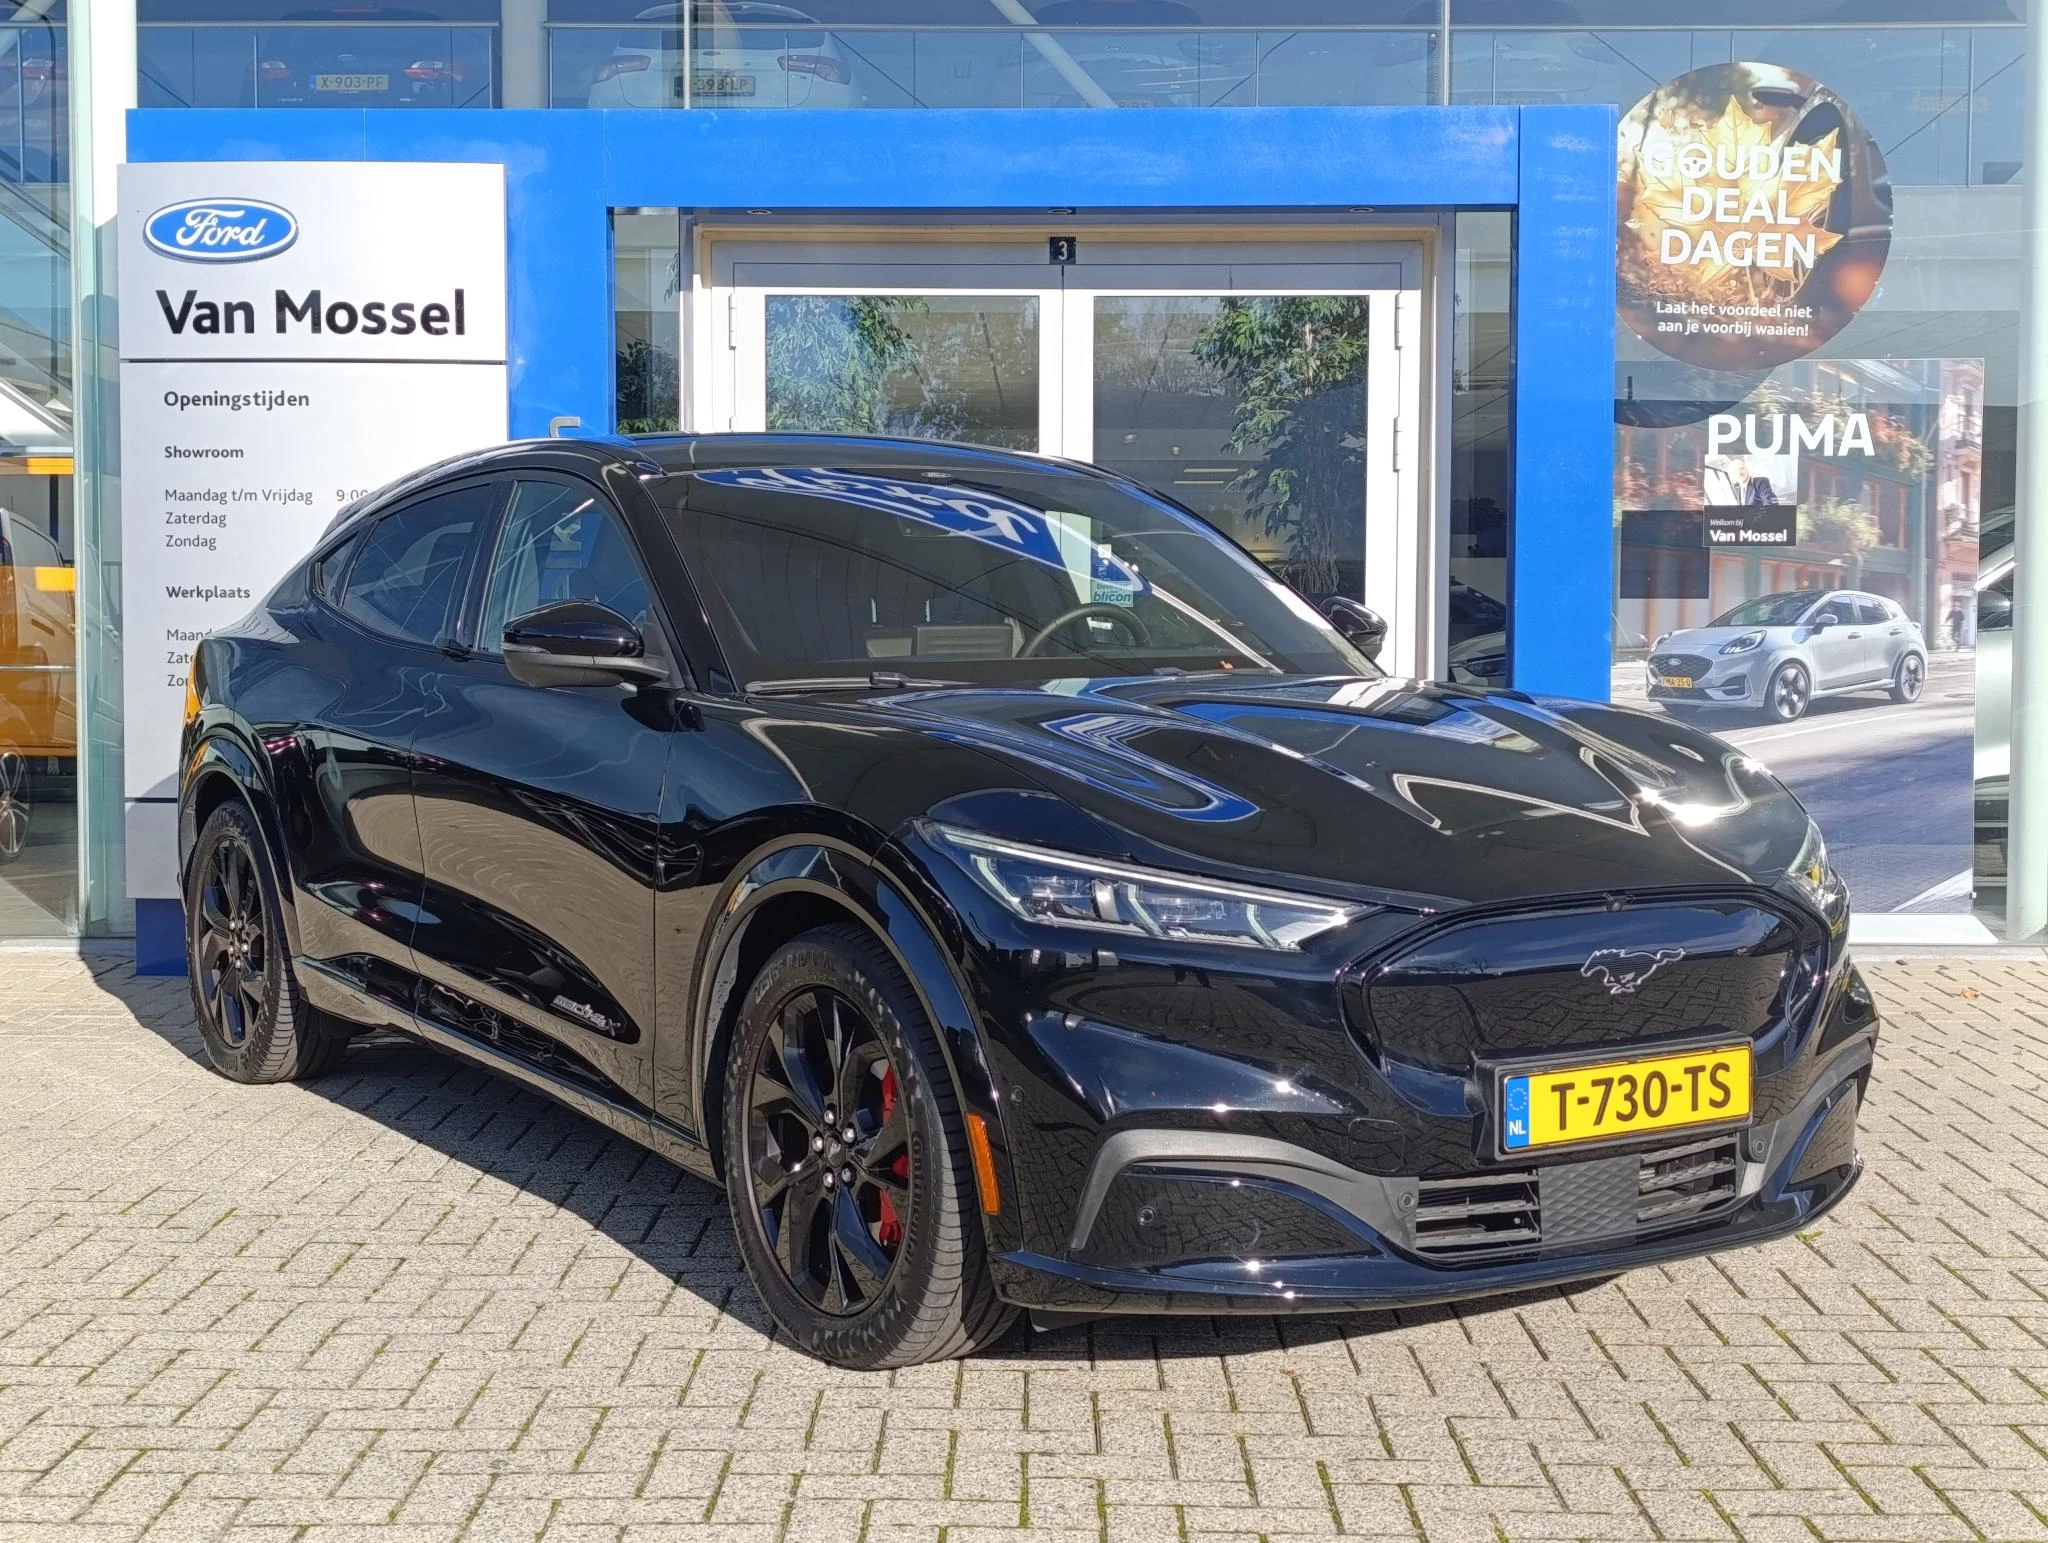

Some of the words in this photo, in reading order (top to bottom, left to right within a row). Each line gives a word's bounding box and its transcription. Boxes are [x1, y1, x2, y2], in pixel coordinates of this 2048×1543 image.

[320, 76, 384, 88] X-903-PF
[686, 78, 748, 91] -398-LP
[1643, 142, 1842, 184] GOUDEN
[1682, 186, 1801, 225] DEAL
[175, 208, 268, 246] Ford
[1058, 240, 1068, 261] 3
[1660, 229, 1816, 269] DAGEN
[155, 289, 255, 335] Van
[275, 288, 465, 336] Mossel
[1656, 301, 1688, 315] Laat
[1691, 302, 1715, 316] het
[1718, 303, 1781, 318] voordeel
[1784, 305, 1813, 319] niet
[1657, 321, 1683, 333] aan
[1684, 319, 1700, 336] je
[1703, 320, 1752, 338] voorbij
[1755, 323, 1809, 337] waaien!
[163, 389, 310, 412] Openingstijden
[1708, 413, 1876, 457] PUMA
[163, 445, 245, 459] Showroom
[164, 488, 228, 506] Maandag
[231, 488, 258, 502] t/m
[261, 488, 313, 506] Vrijdag
[164, 511, 227, 528] Zaterdag
[1710, 518, 1735, 527] Welkom
[164, 534, 217, 551] Zondag
[1709, 528, 1736, 542] Van
[1739, 528, 1788, 542] Mossel
[165, 585, 251, 602] Werkplaats
[1093, 591, 1131, 602] blicon
[1550, 1062, 1731, 1131] T-730-TS
[1509, 1120, 1526, 1135] NL
